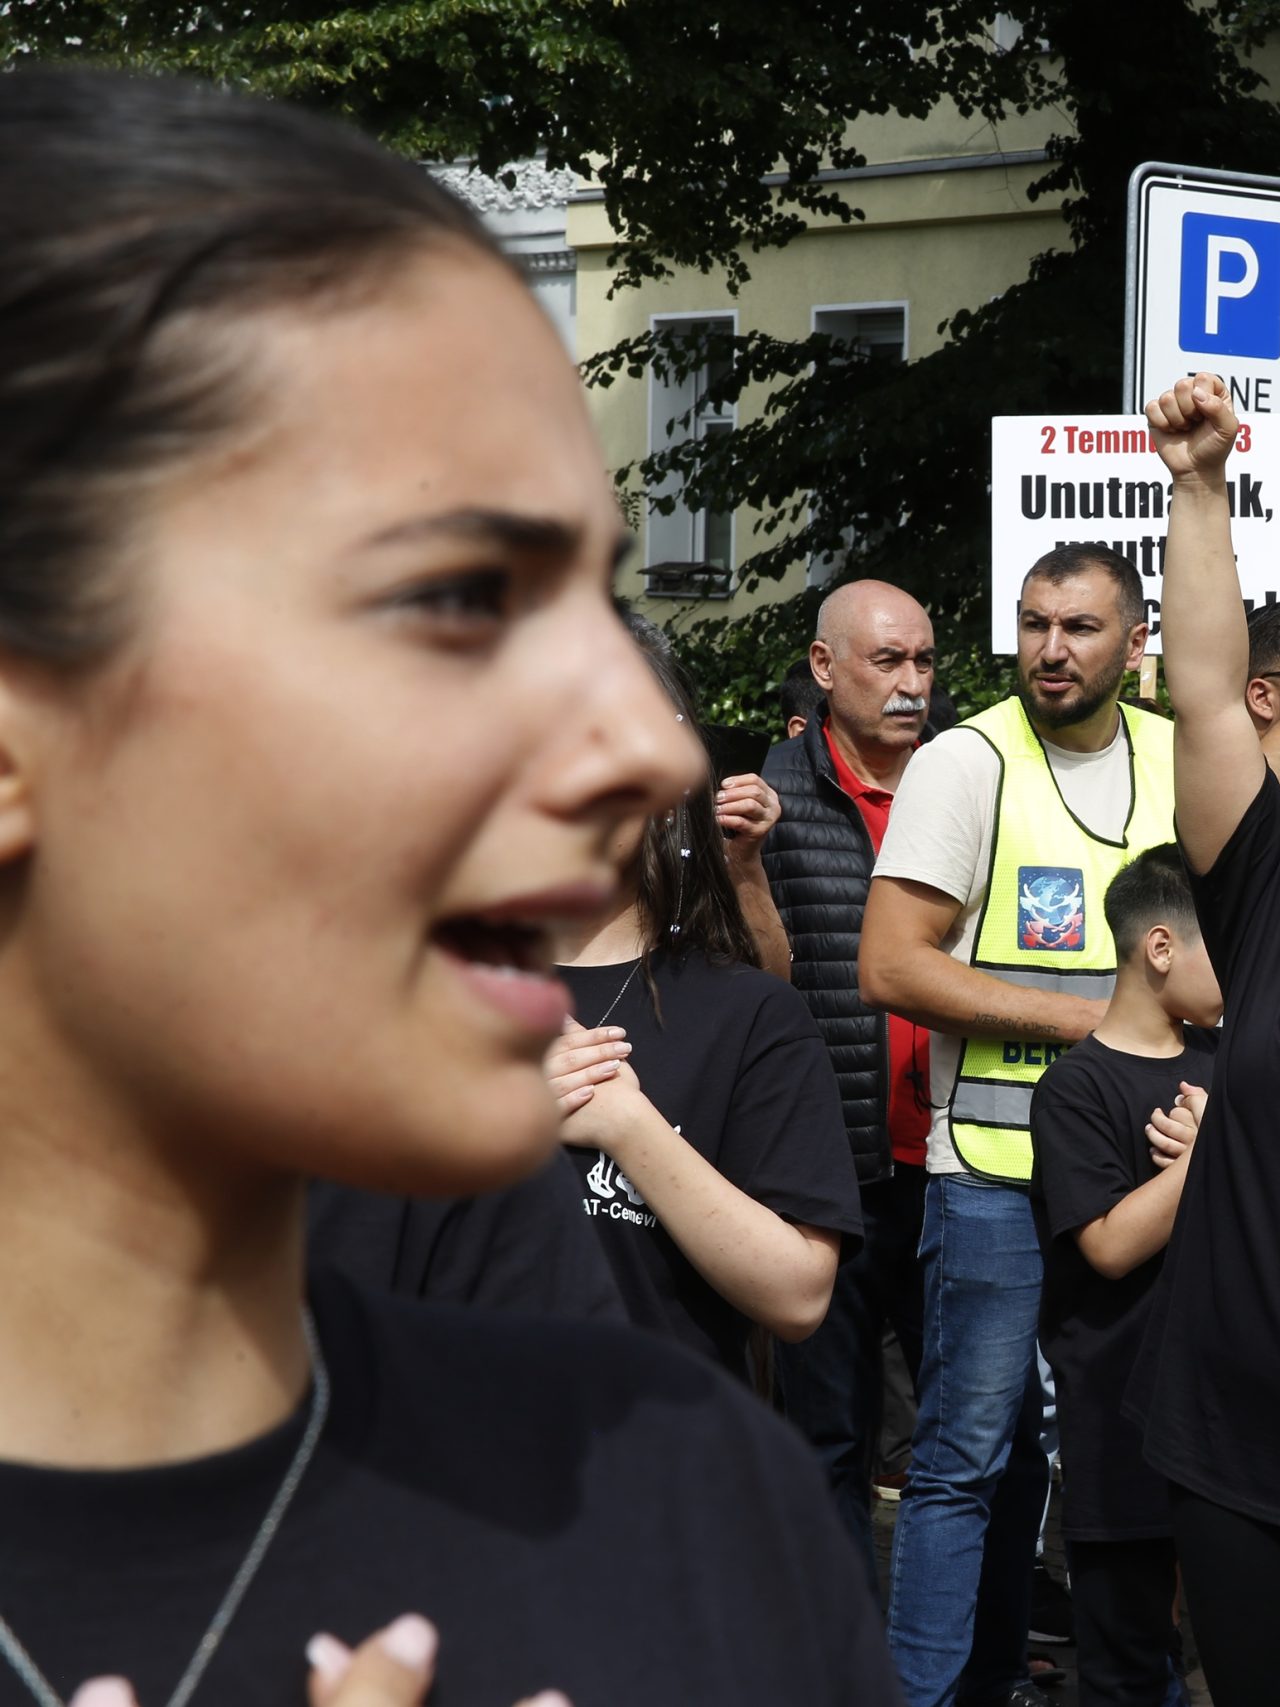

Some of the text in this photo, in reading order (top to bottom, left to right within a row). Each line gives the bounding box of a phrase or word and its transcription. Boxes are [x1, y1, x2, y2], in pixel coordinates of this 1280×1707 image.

[1204, 234, 1260, 336] P
[1187, 371, 1273, 414] NE
[1040, 425, 1057, 454] 2
[1002, 1040, 1074, 1066] BER
